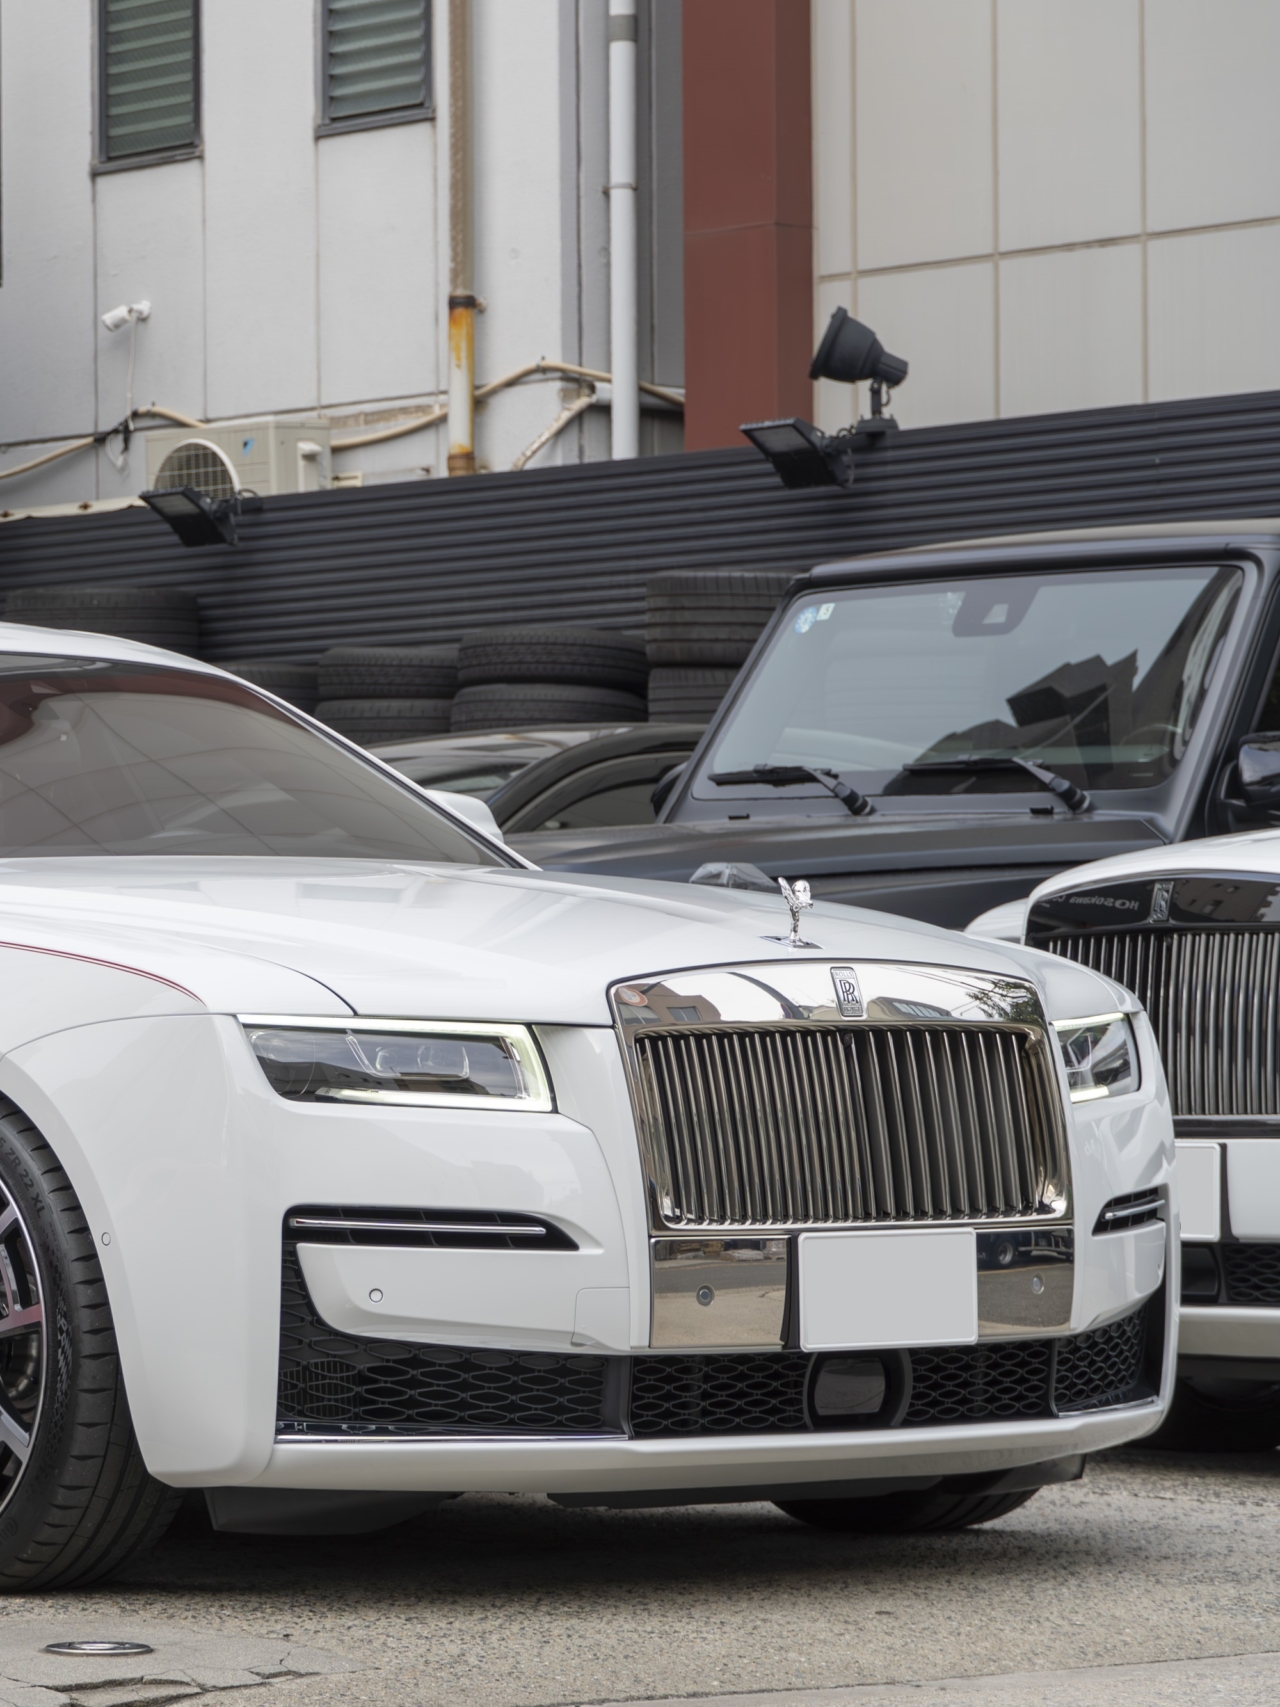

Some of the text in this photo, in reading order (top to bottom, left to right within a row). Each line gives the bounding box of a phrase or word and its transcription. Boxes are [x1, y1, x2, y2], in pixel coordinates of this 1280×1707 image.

[5, 1147, 22, 1170] ZR
[19, 1169, 35, 1192] 22
[31, 1192, 46, 1219] XL
